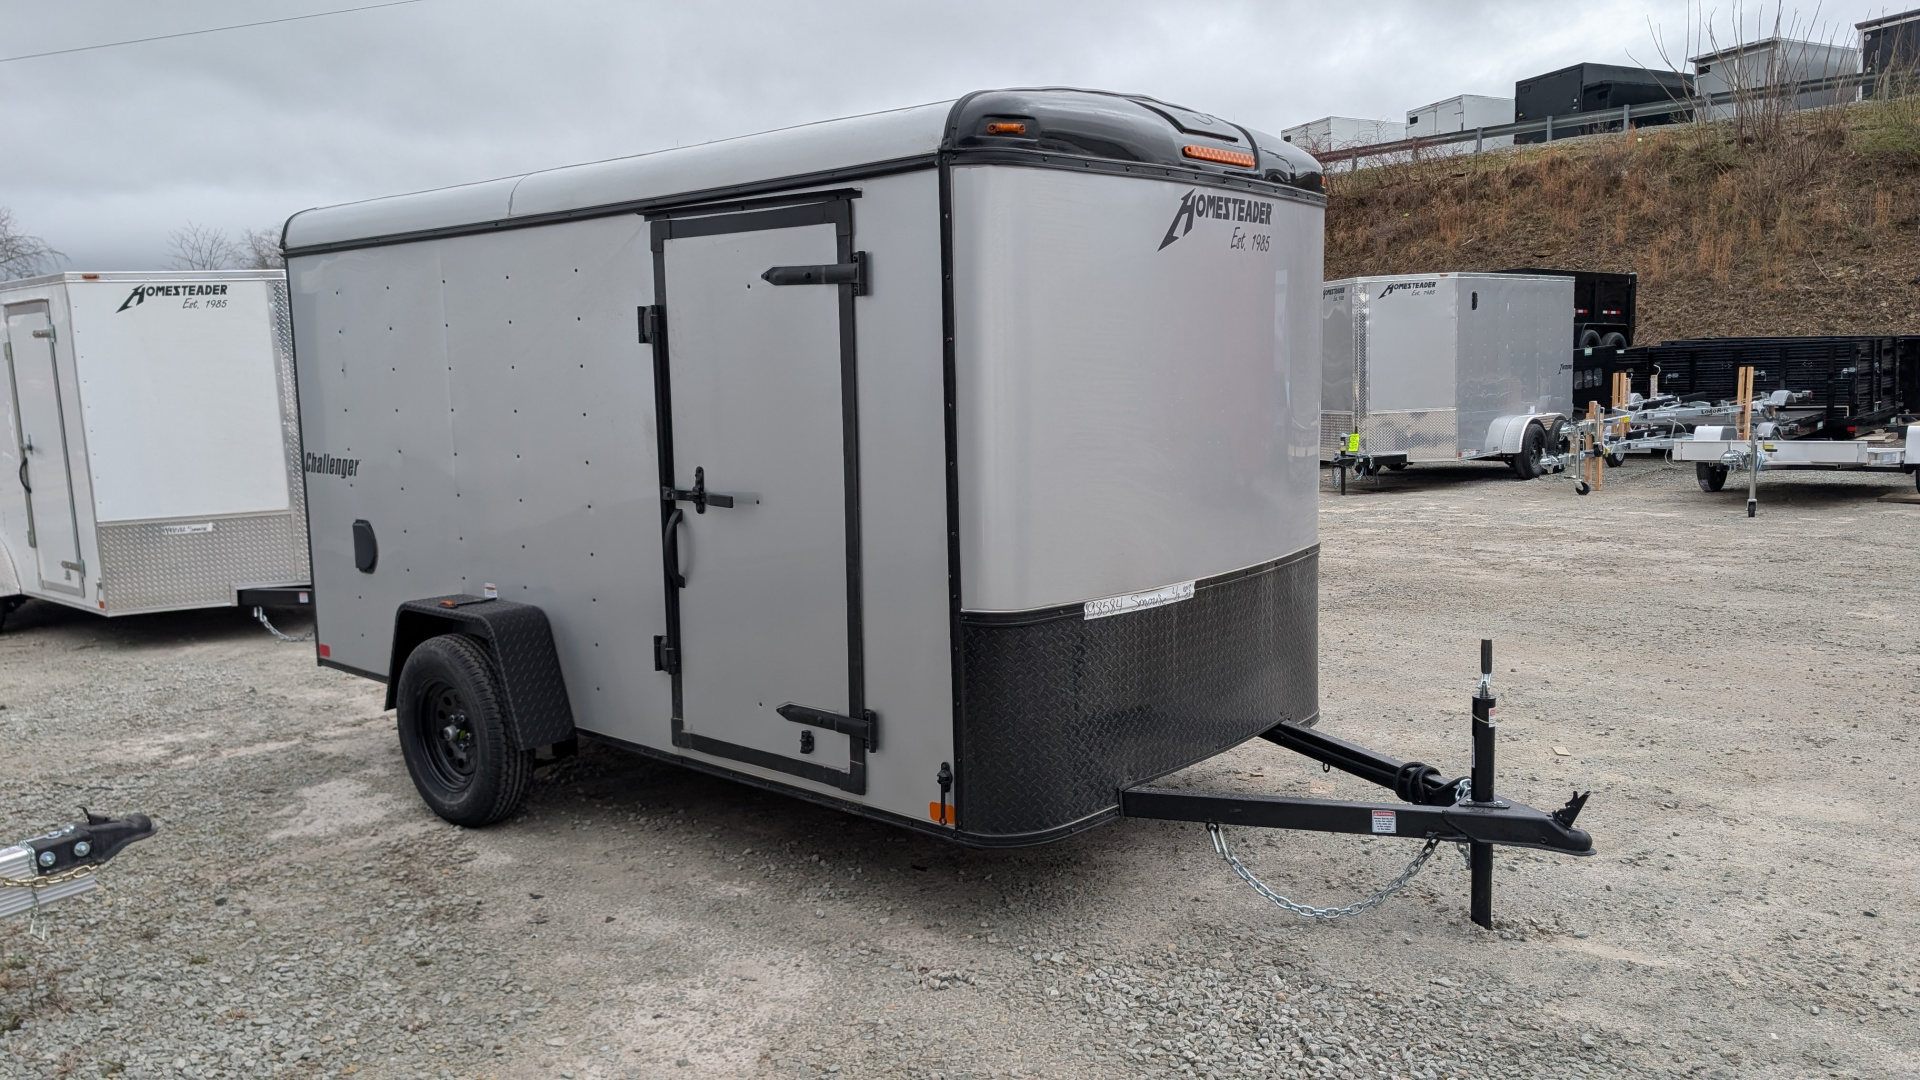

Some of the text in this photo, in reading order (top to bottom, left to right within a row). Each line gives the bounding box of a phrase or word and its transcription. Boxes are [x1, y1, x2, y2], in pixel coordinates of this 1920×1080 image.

[1157, 188, 1273, 252] HOMESTEADER
[1231, 227, 1271, 252] Est. 1985
[115, 284, 228, 313] HOMESTEADER
[1378, 281, 1437, 299] HOMESTEADER
[182, 298, 228, 309] Est. 1985
[305, 452, 359, 479] Challenger
